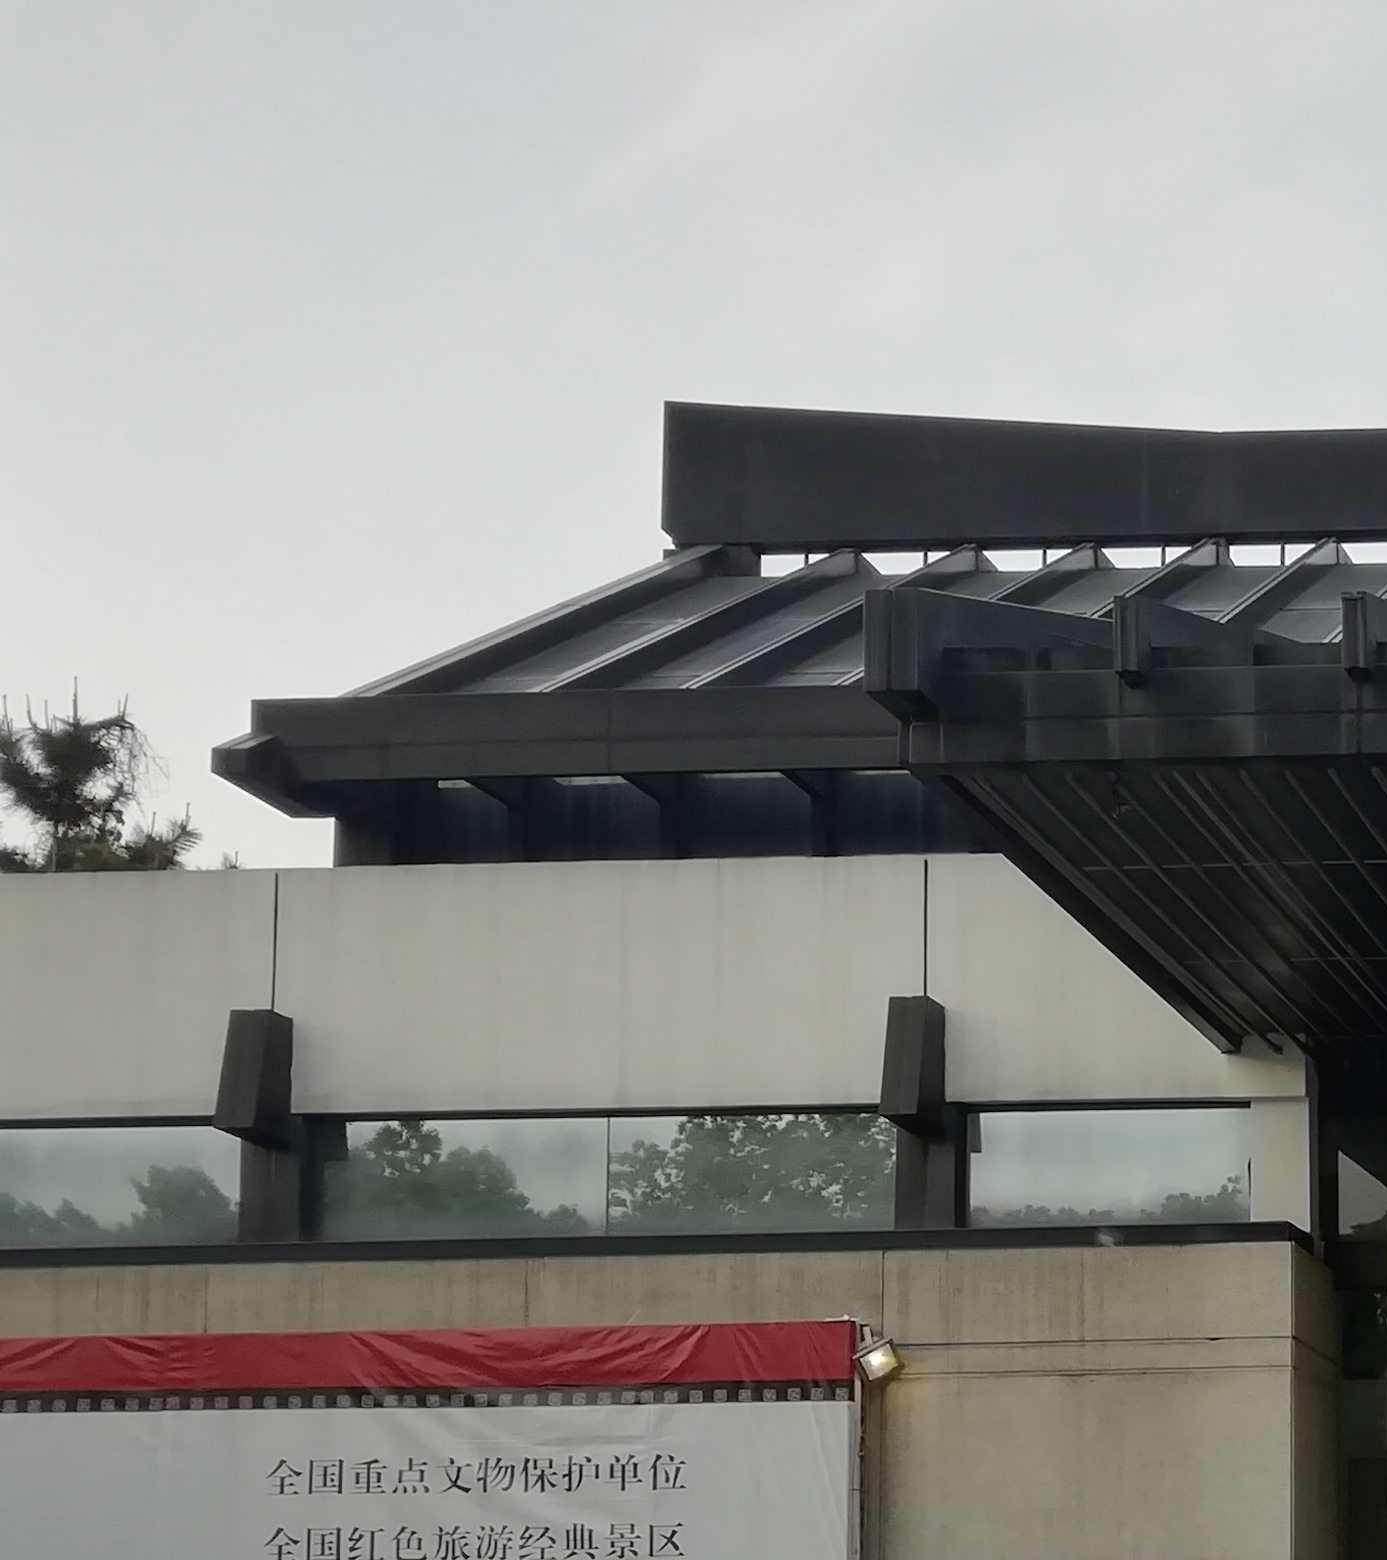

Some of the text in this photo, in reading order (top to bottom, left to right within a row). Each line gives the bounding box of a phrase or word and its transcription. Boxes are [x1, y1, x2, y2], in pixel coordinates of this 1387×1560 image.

[265, 1454, 688, 1497] 全国重点文物保护单位
